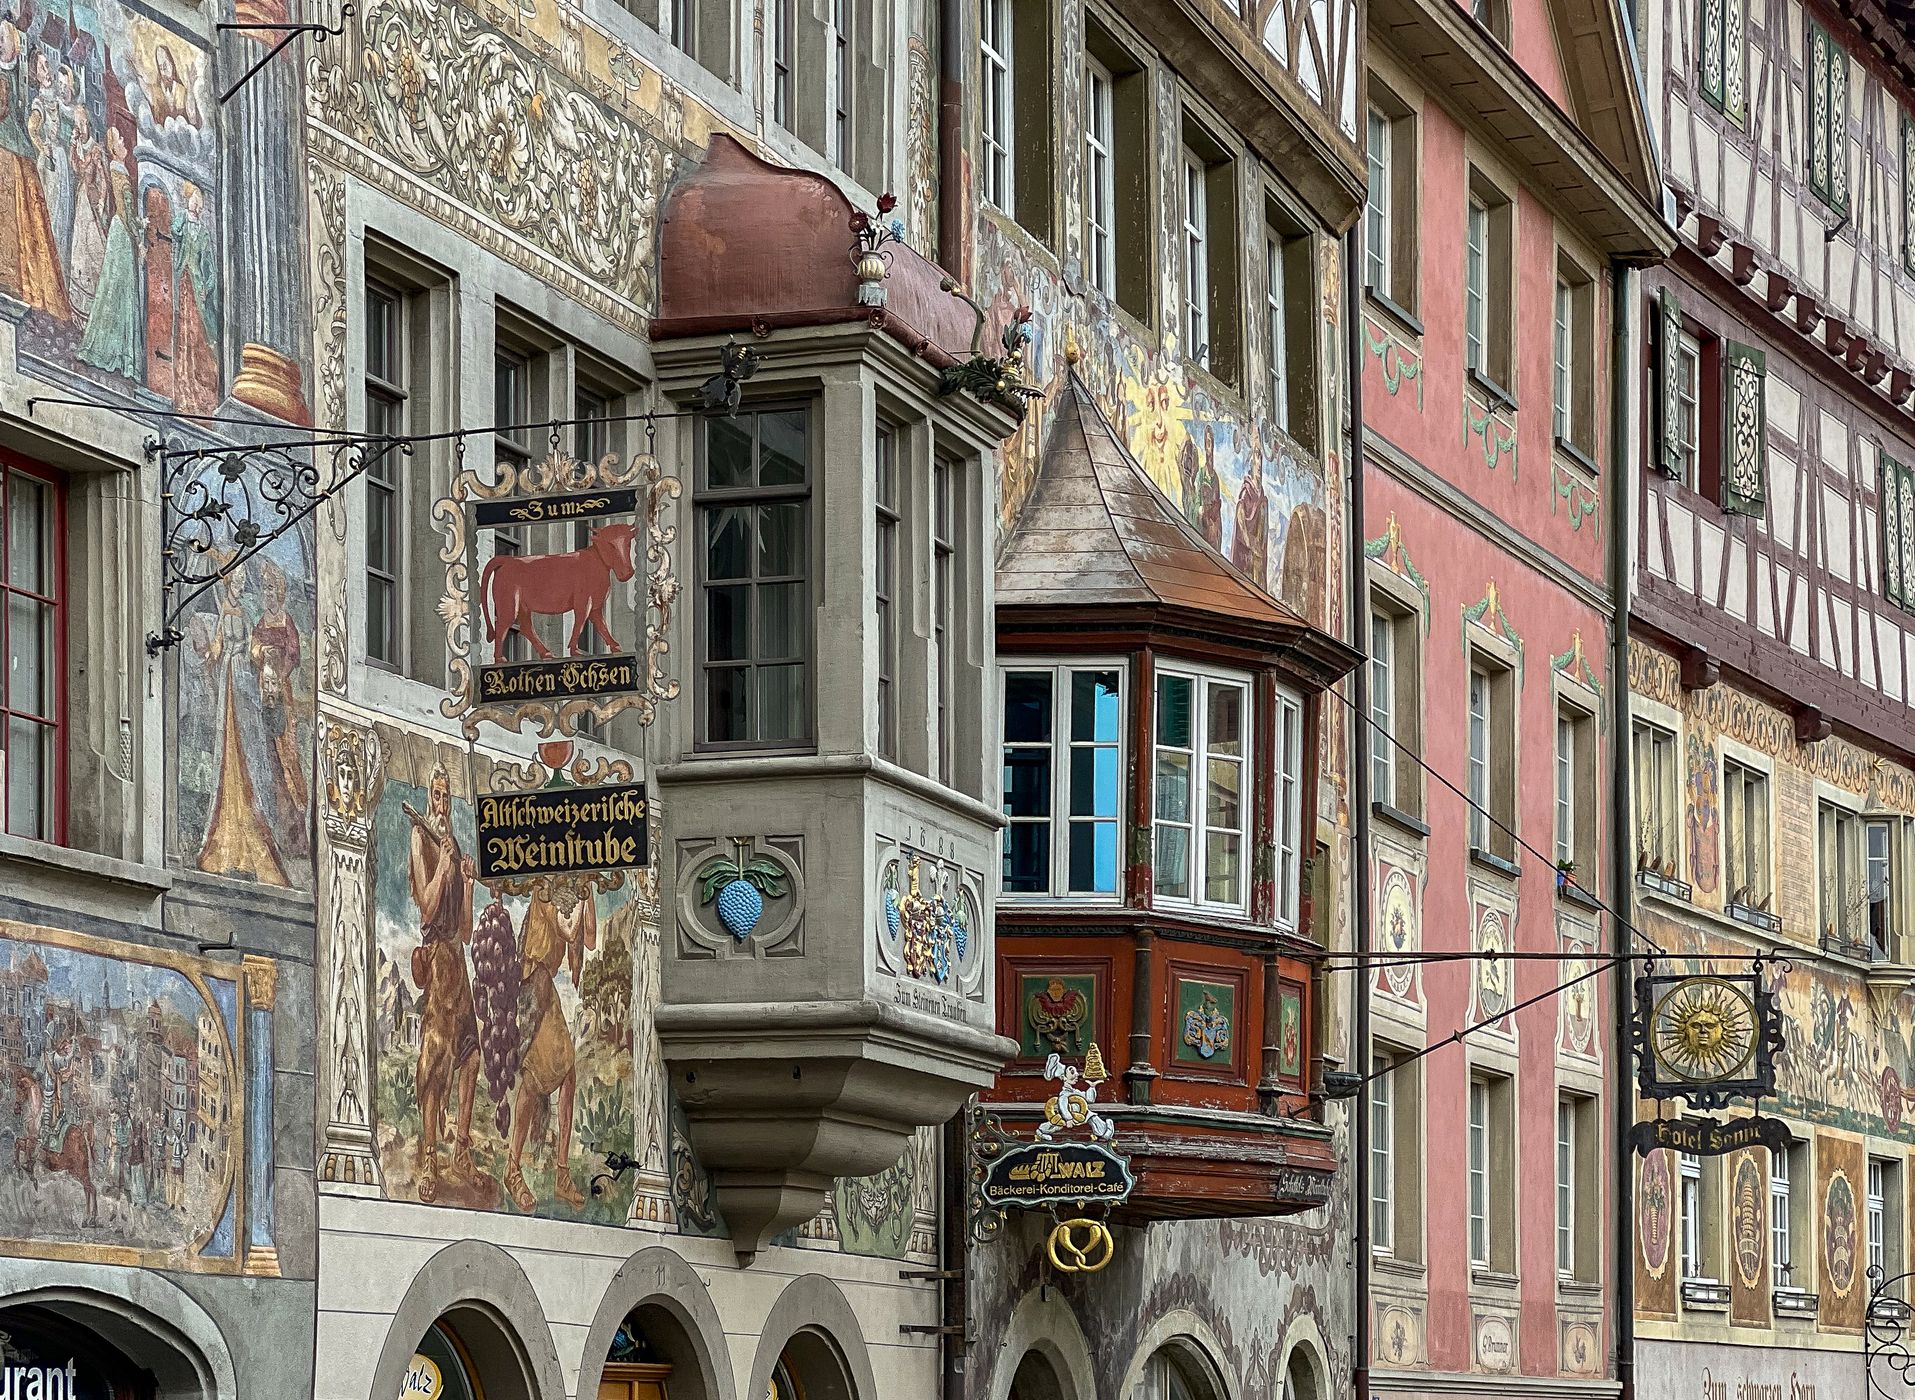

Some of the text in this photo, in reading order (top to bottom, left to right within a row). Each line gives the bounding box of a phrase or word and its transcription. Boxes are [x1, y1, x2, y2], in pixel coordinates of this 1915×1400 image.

[513, 498, 592, 521] Zum
[484, 661, 631, 695] Rothen Ochsen
[479, 789, 646, 833] Altschweizerische
[487, 827, 637, 872] Weinstube
[893, 982, 911, 1006] Zum
[1656, 1122, 1703, 1150] Hotel
[1057, 1160, 1106, 1179] WALZ
[989, 1181, 1124, 1196] Bäckerei-Konditorei-Café
